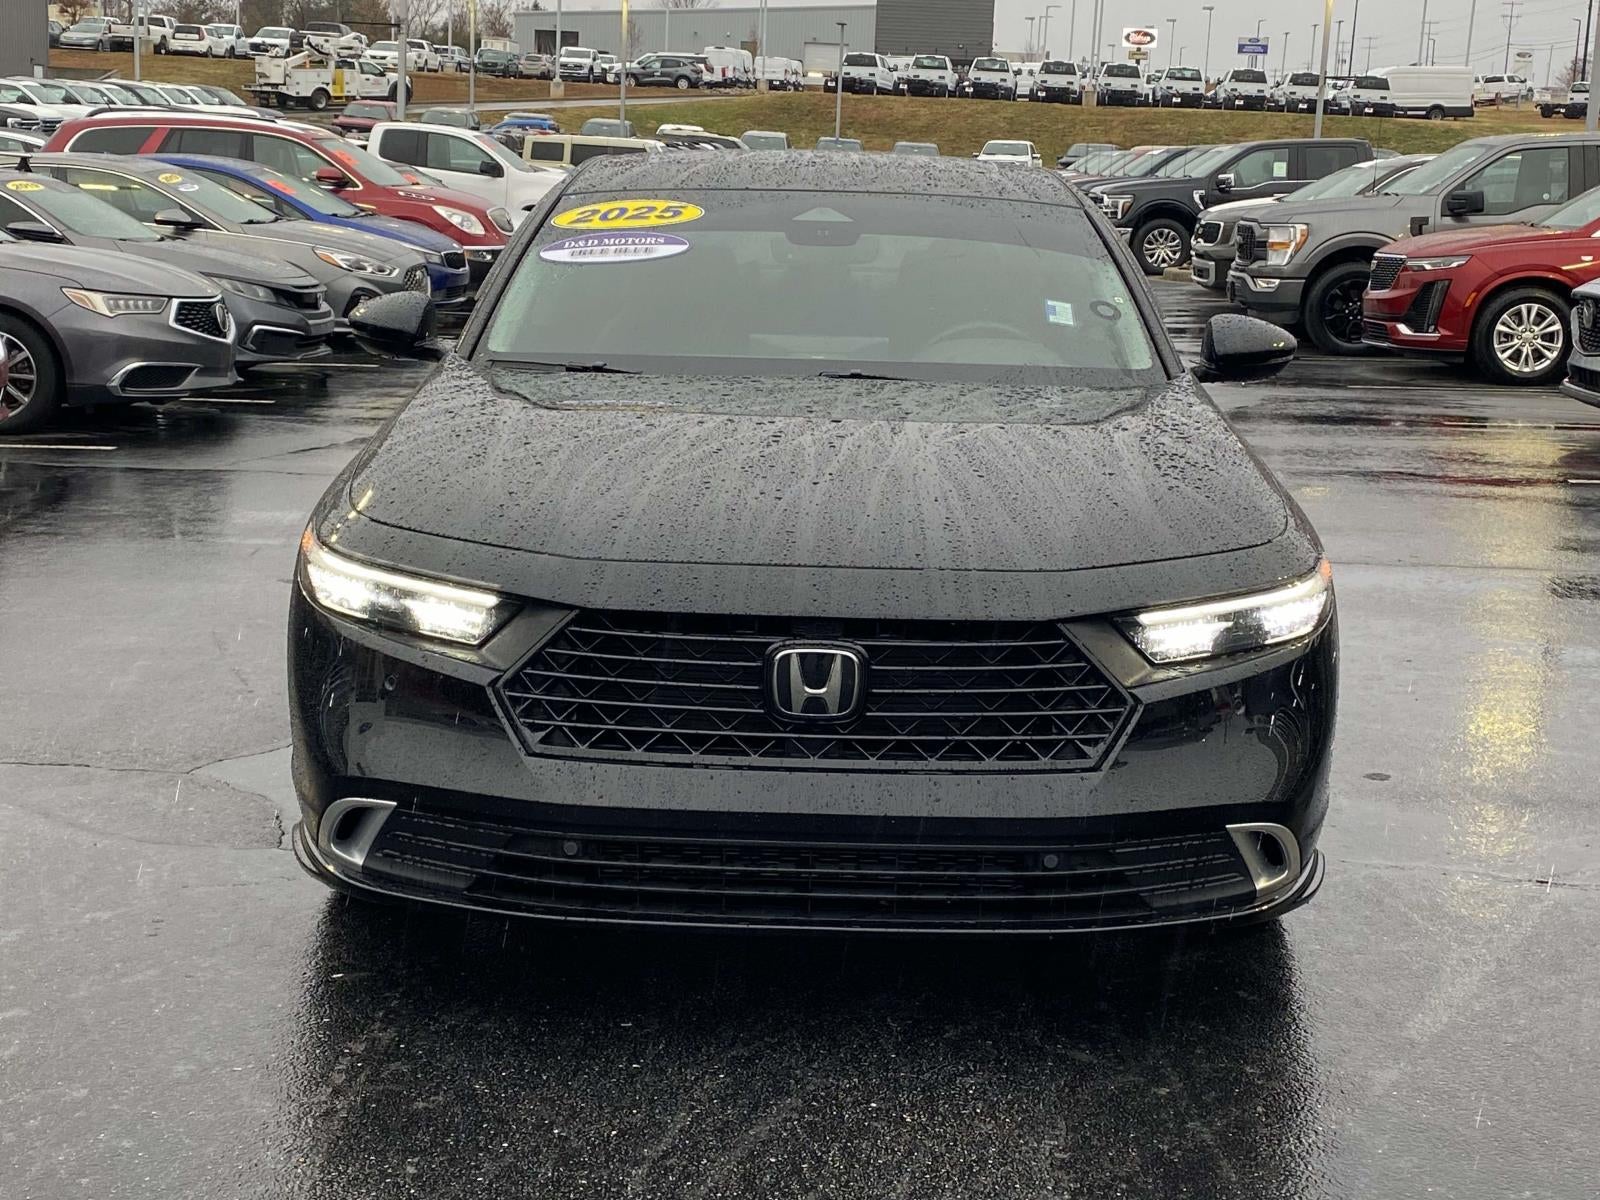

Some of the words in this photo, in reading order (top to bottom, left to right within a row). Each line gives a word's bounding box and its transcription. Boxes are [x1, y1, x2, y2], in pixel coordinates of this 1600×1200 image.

[567, 205, 689, 225] 2025
[563, 238, 598, 249] D&D
[600, 236, 665, 246] MOTORS
